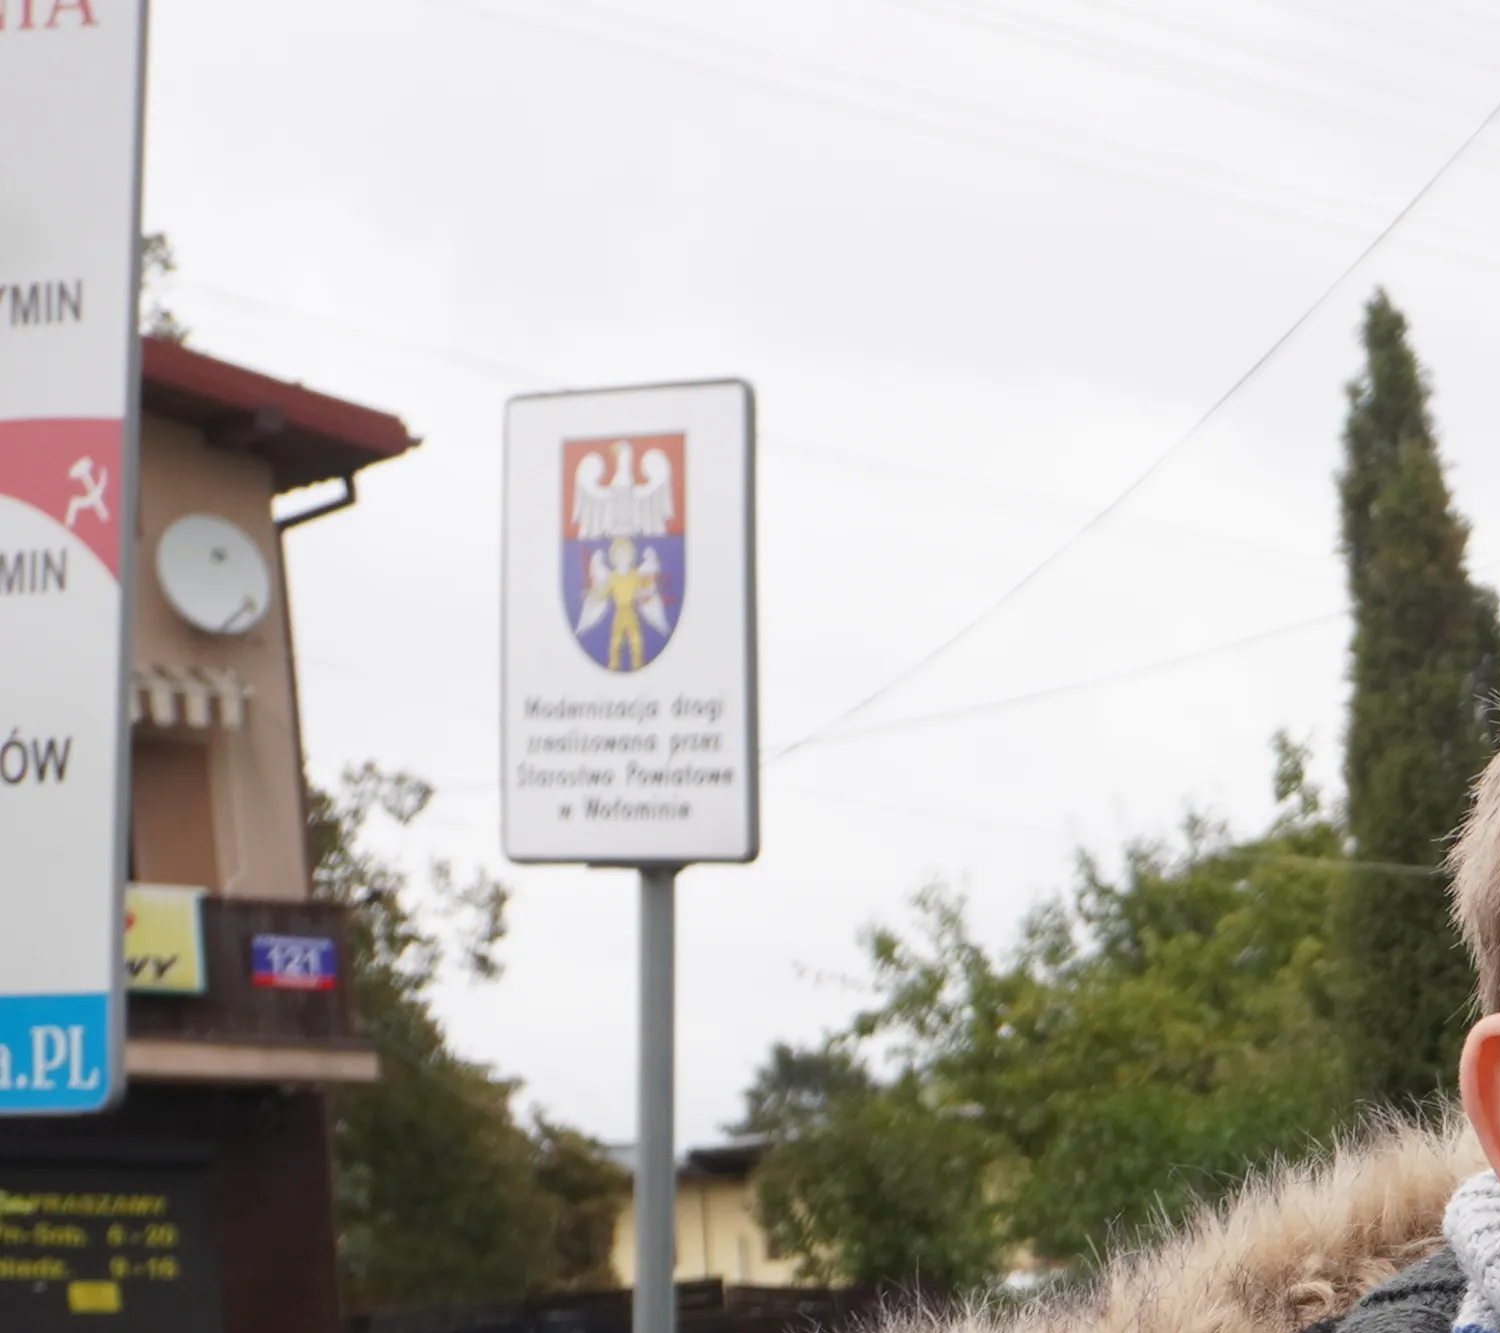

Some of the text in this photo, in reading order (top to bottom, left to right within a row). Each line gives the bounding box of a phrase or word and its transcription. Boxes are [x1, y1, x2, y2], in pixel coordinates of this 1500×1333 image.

[0, 279, 83, 327] MIN
[670, 692, 725, 723] drogi
[667, 732, 723, 762] przez
[516, 760, 736, 788] Starostwo Powiatowe
[583, 795, 693, 822] Wołominie
[265, 945, 321, 976] 121
